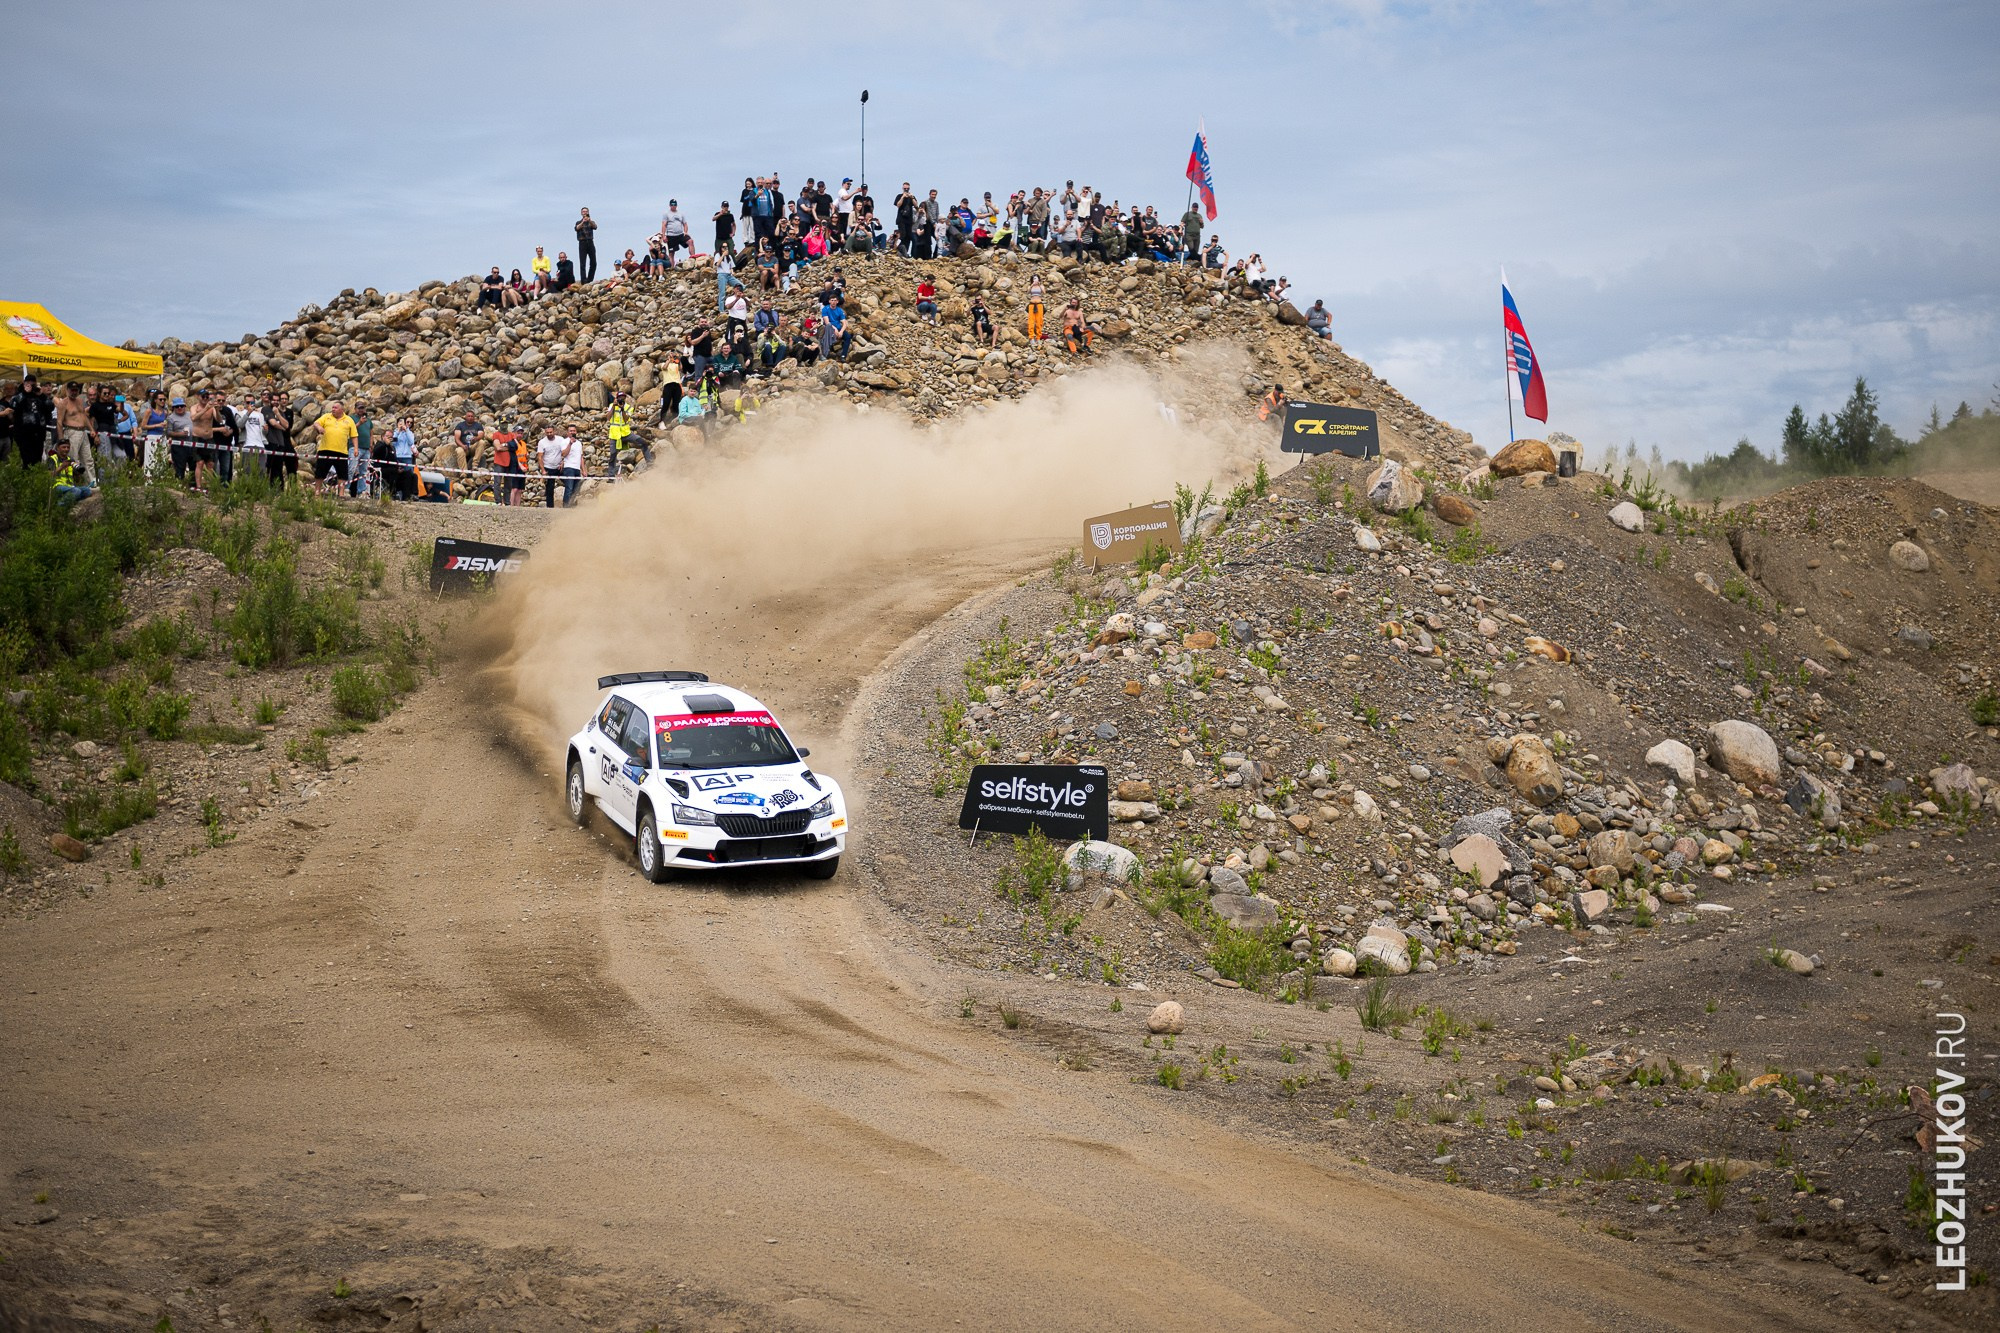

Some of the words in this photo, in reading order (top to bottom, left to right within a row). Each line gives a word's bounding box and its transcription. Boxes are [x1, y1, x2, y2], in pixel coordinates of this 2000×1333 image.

[28, 354, 82, 366] ТРЕНЕРСКАЯ
[1113, 521, 1168, 535] КОРПОРАЦИЯ
[1114, 534, 1136, 542] РУСЬ
[673, 717, 713, 727] РАЛЛИ
[663, 732, 672, 743] 8
[978, 803, 1007, 811] фабрика
[1036, 809, 1085, 820] selfstylemebel.ru
